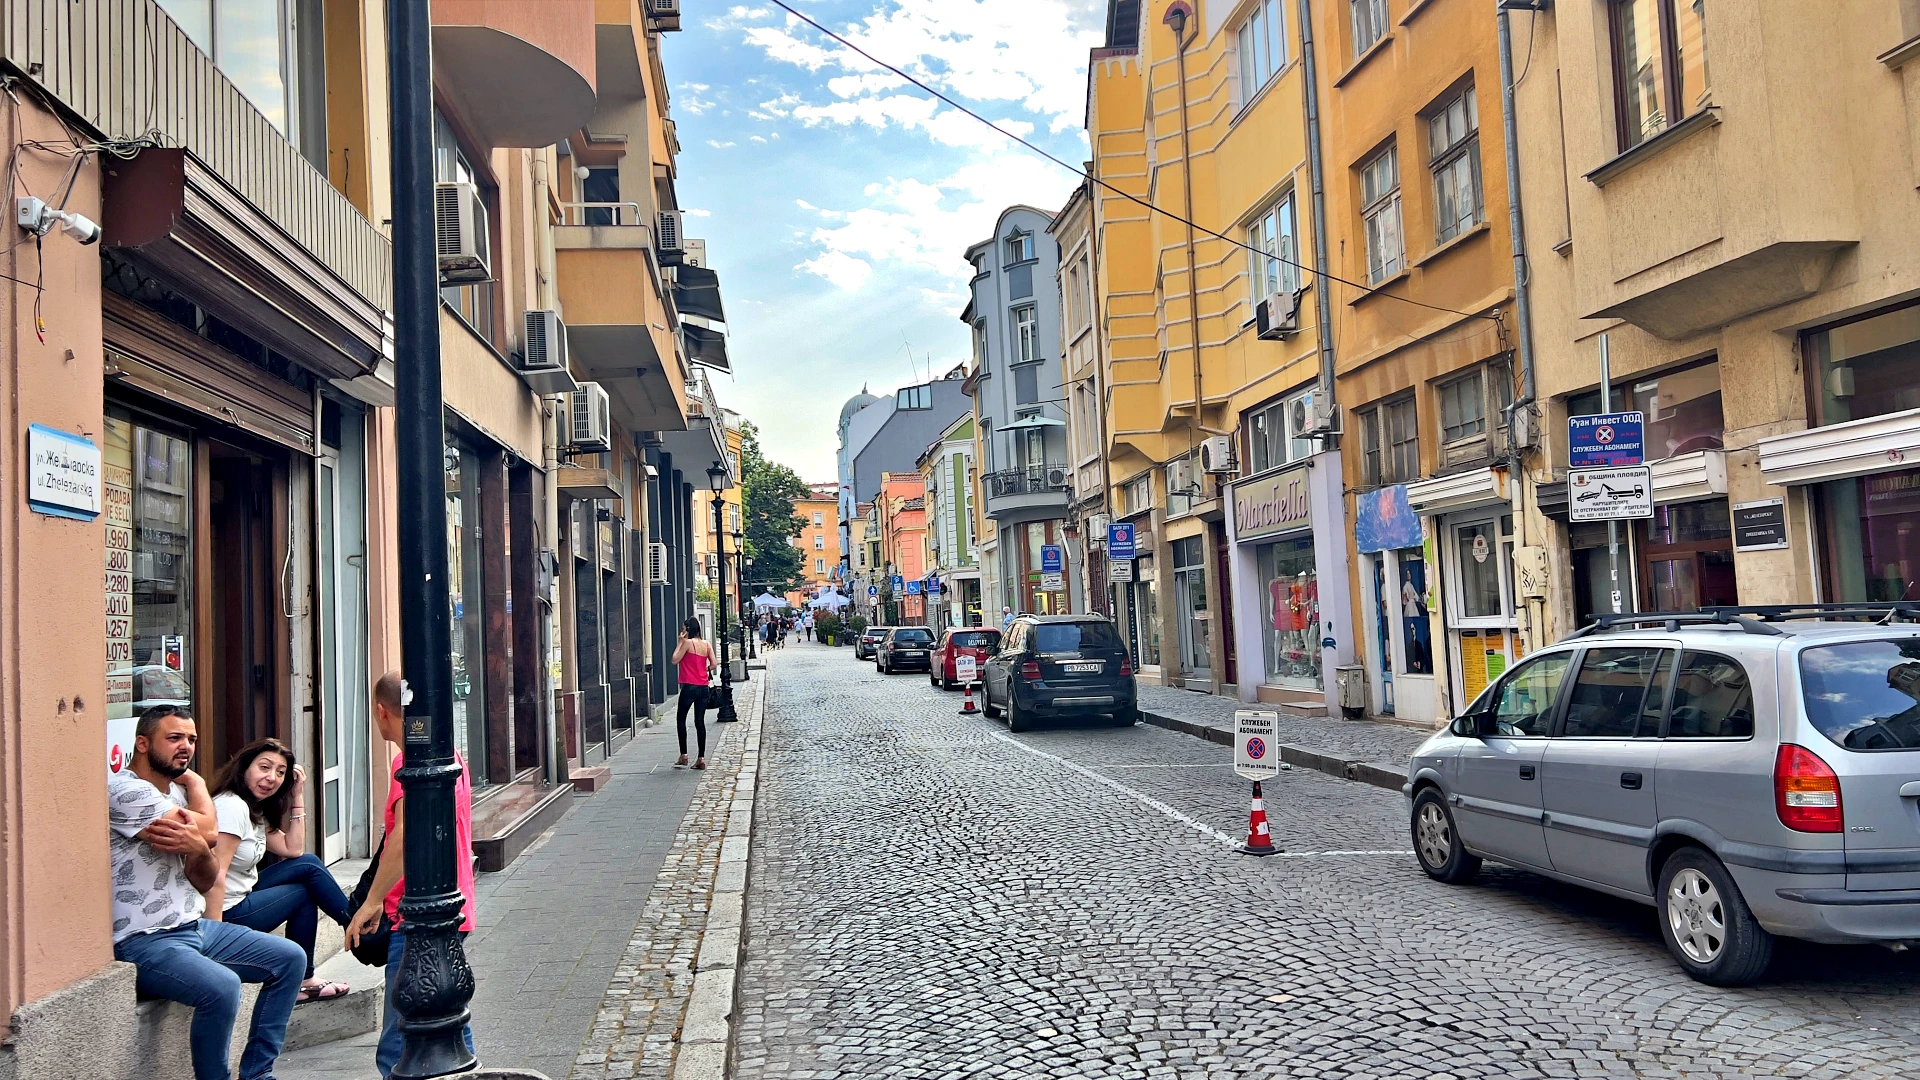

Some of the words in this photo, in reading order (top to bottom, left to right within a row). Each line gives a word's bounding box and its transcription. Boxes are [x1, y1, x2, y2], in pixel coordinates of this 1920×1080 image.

[1571, 418, 1590, 428] Руан
[1592, 417, 1621, 426] Инвест
[1622, 413, 1642, 424] ООД
[1572, 445, 1604, 453] СЛУЖЕБЕН
[1604, 443, 1640, 451] АБОНАМЕНТ
[1237, 479, 1309, 532] Marchella
[1241, 719, 1271, 727] СЛУЖЕБЕН
[1239, 727, 1273, 735] АБОНАМЕНТ
